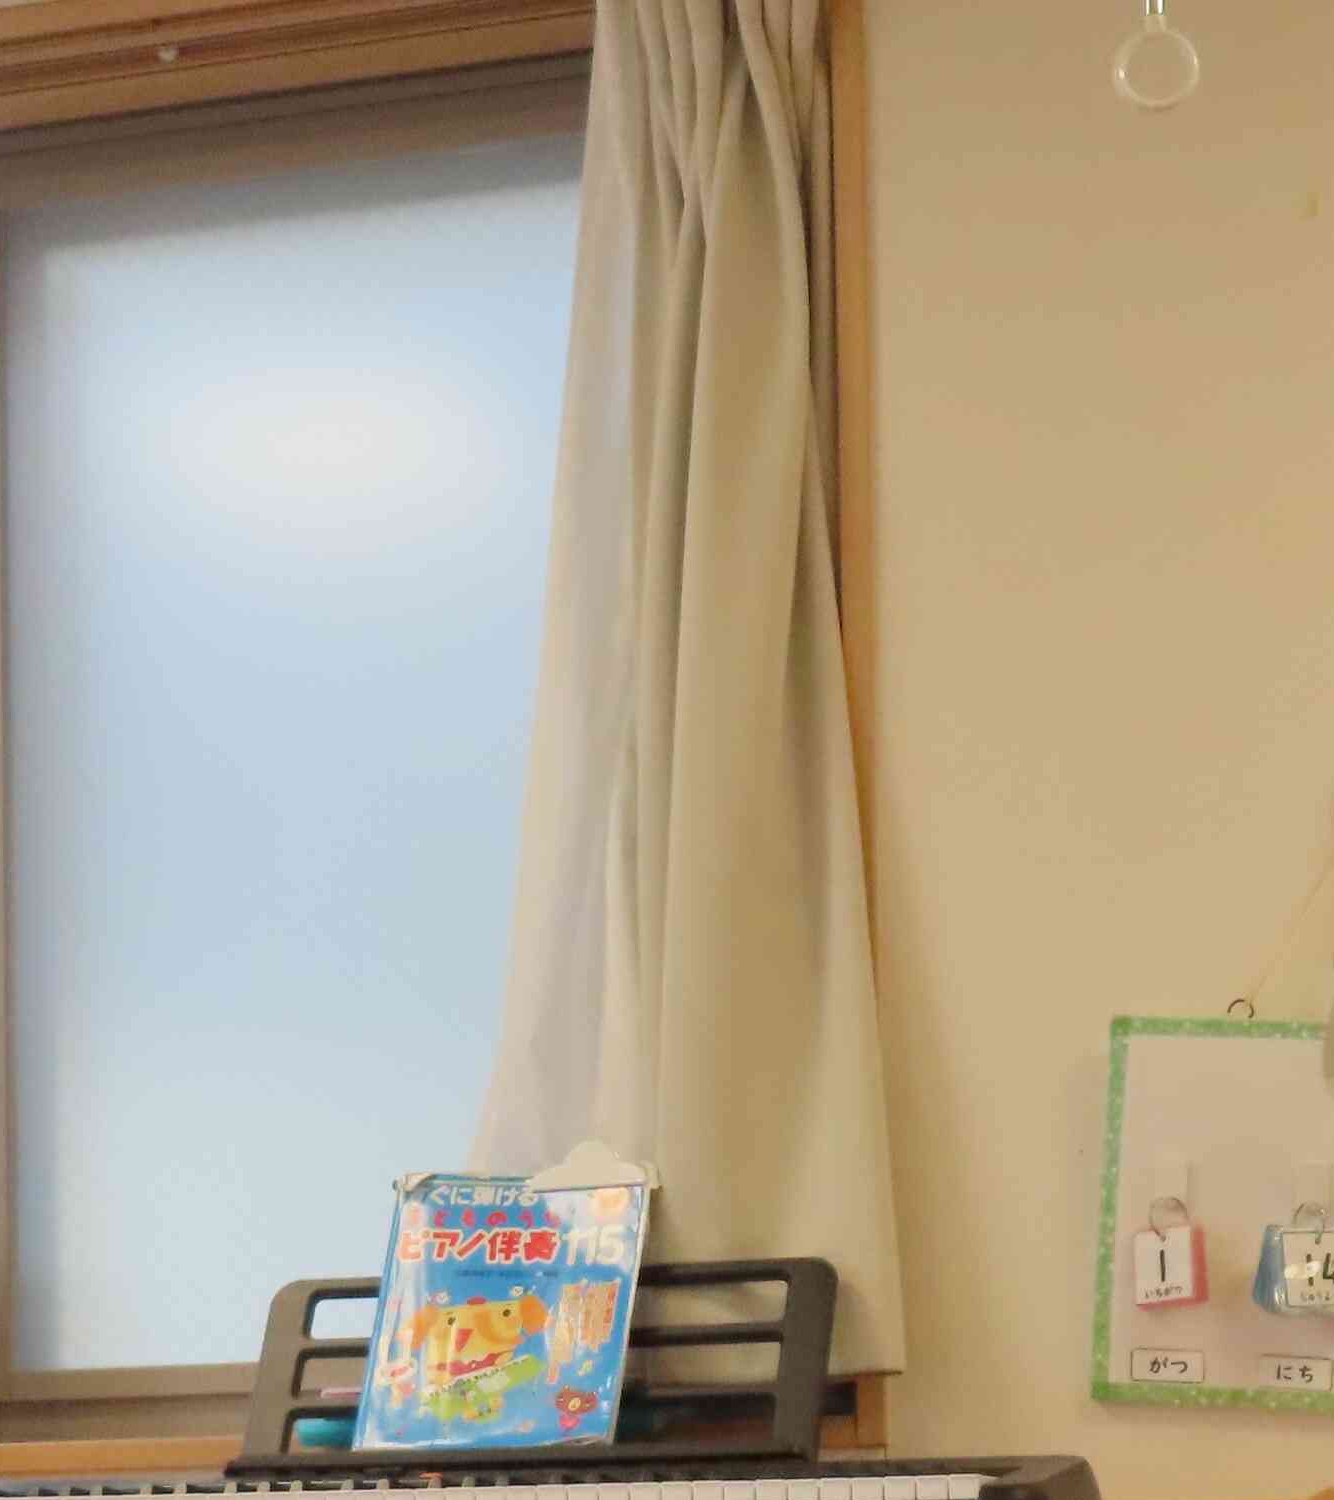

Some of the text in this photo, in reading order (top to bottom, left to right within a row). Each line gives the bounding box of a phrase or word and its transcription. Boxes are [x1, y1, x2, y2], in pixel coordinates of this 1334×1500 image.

[1159, 1249, 1166, 1283] 1
[1148, 1356, 1189, 1374] がつ
[1275, 1364, 1314, 1384] にち
